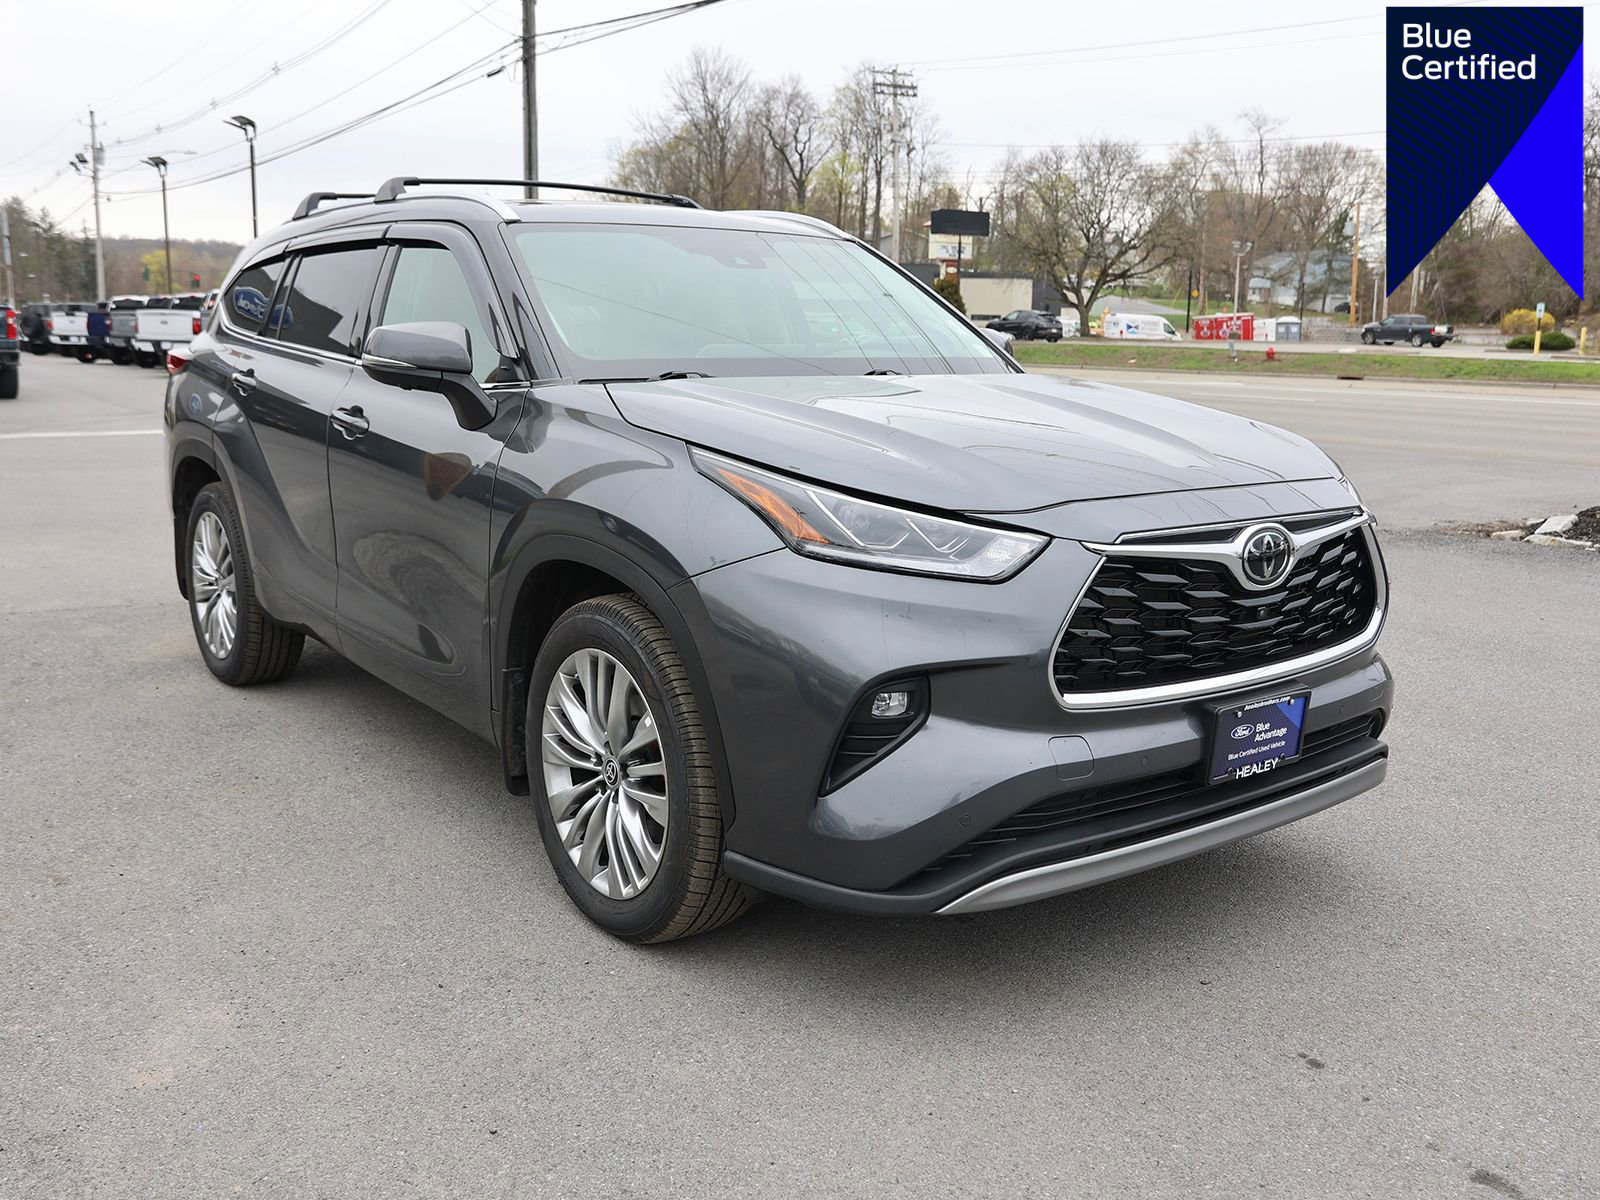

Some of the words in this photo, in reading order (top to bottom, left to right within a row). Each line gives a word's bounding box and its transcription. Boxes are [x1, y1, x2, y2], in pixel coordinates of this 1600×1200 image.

[1234, 725, 1251, 738] Ford
[1254, 727, 1288, 742] Advantage
[1256, 723, 1270, 732] Blue
[1240, 747, 1258, 757] Certified
[1271, 741, 1286, 749] Vehicle
[1236, 758, 1278, 779] HEALEY
